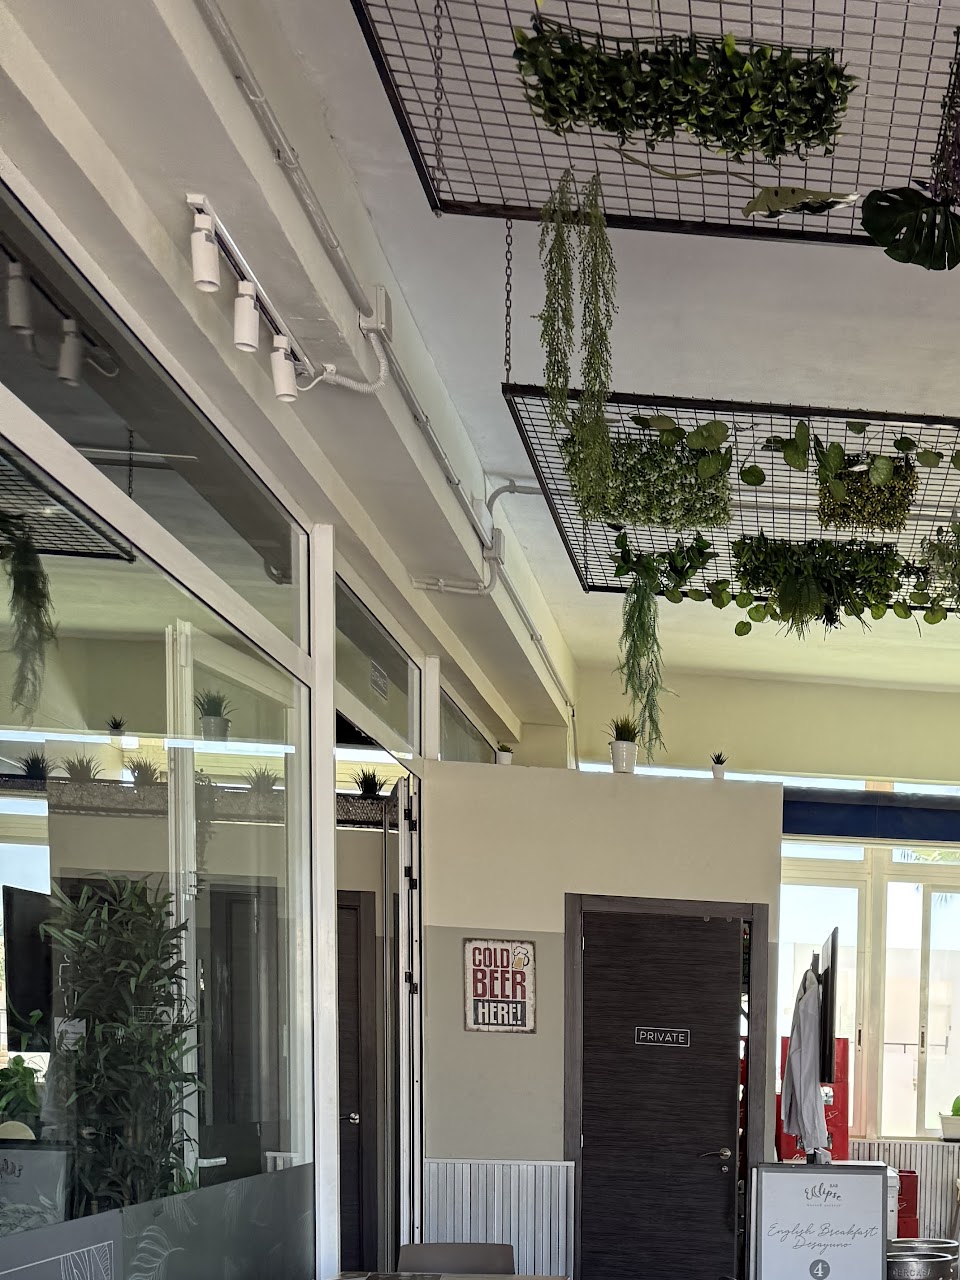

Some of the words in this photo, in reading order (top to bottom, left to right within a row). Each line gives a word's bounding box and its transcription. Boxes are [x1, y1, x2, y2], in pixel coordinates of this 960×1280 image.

[472, 946, 510, 969] COLD
[472, 968, 527, 1000] BEER
[477, 1002, 522, 1025] HERE!
[639, 1030, 685, 1043] PRIVATE
[767, 1222, 815, 1243] English
[818, 1222, 879, 1240] Breakfast
[792, 1235, 852, 1256] Desayuno
